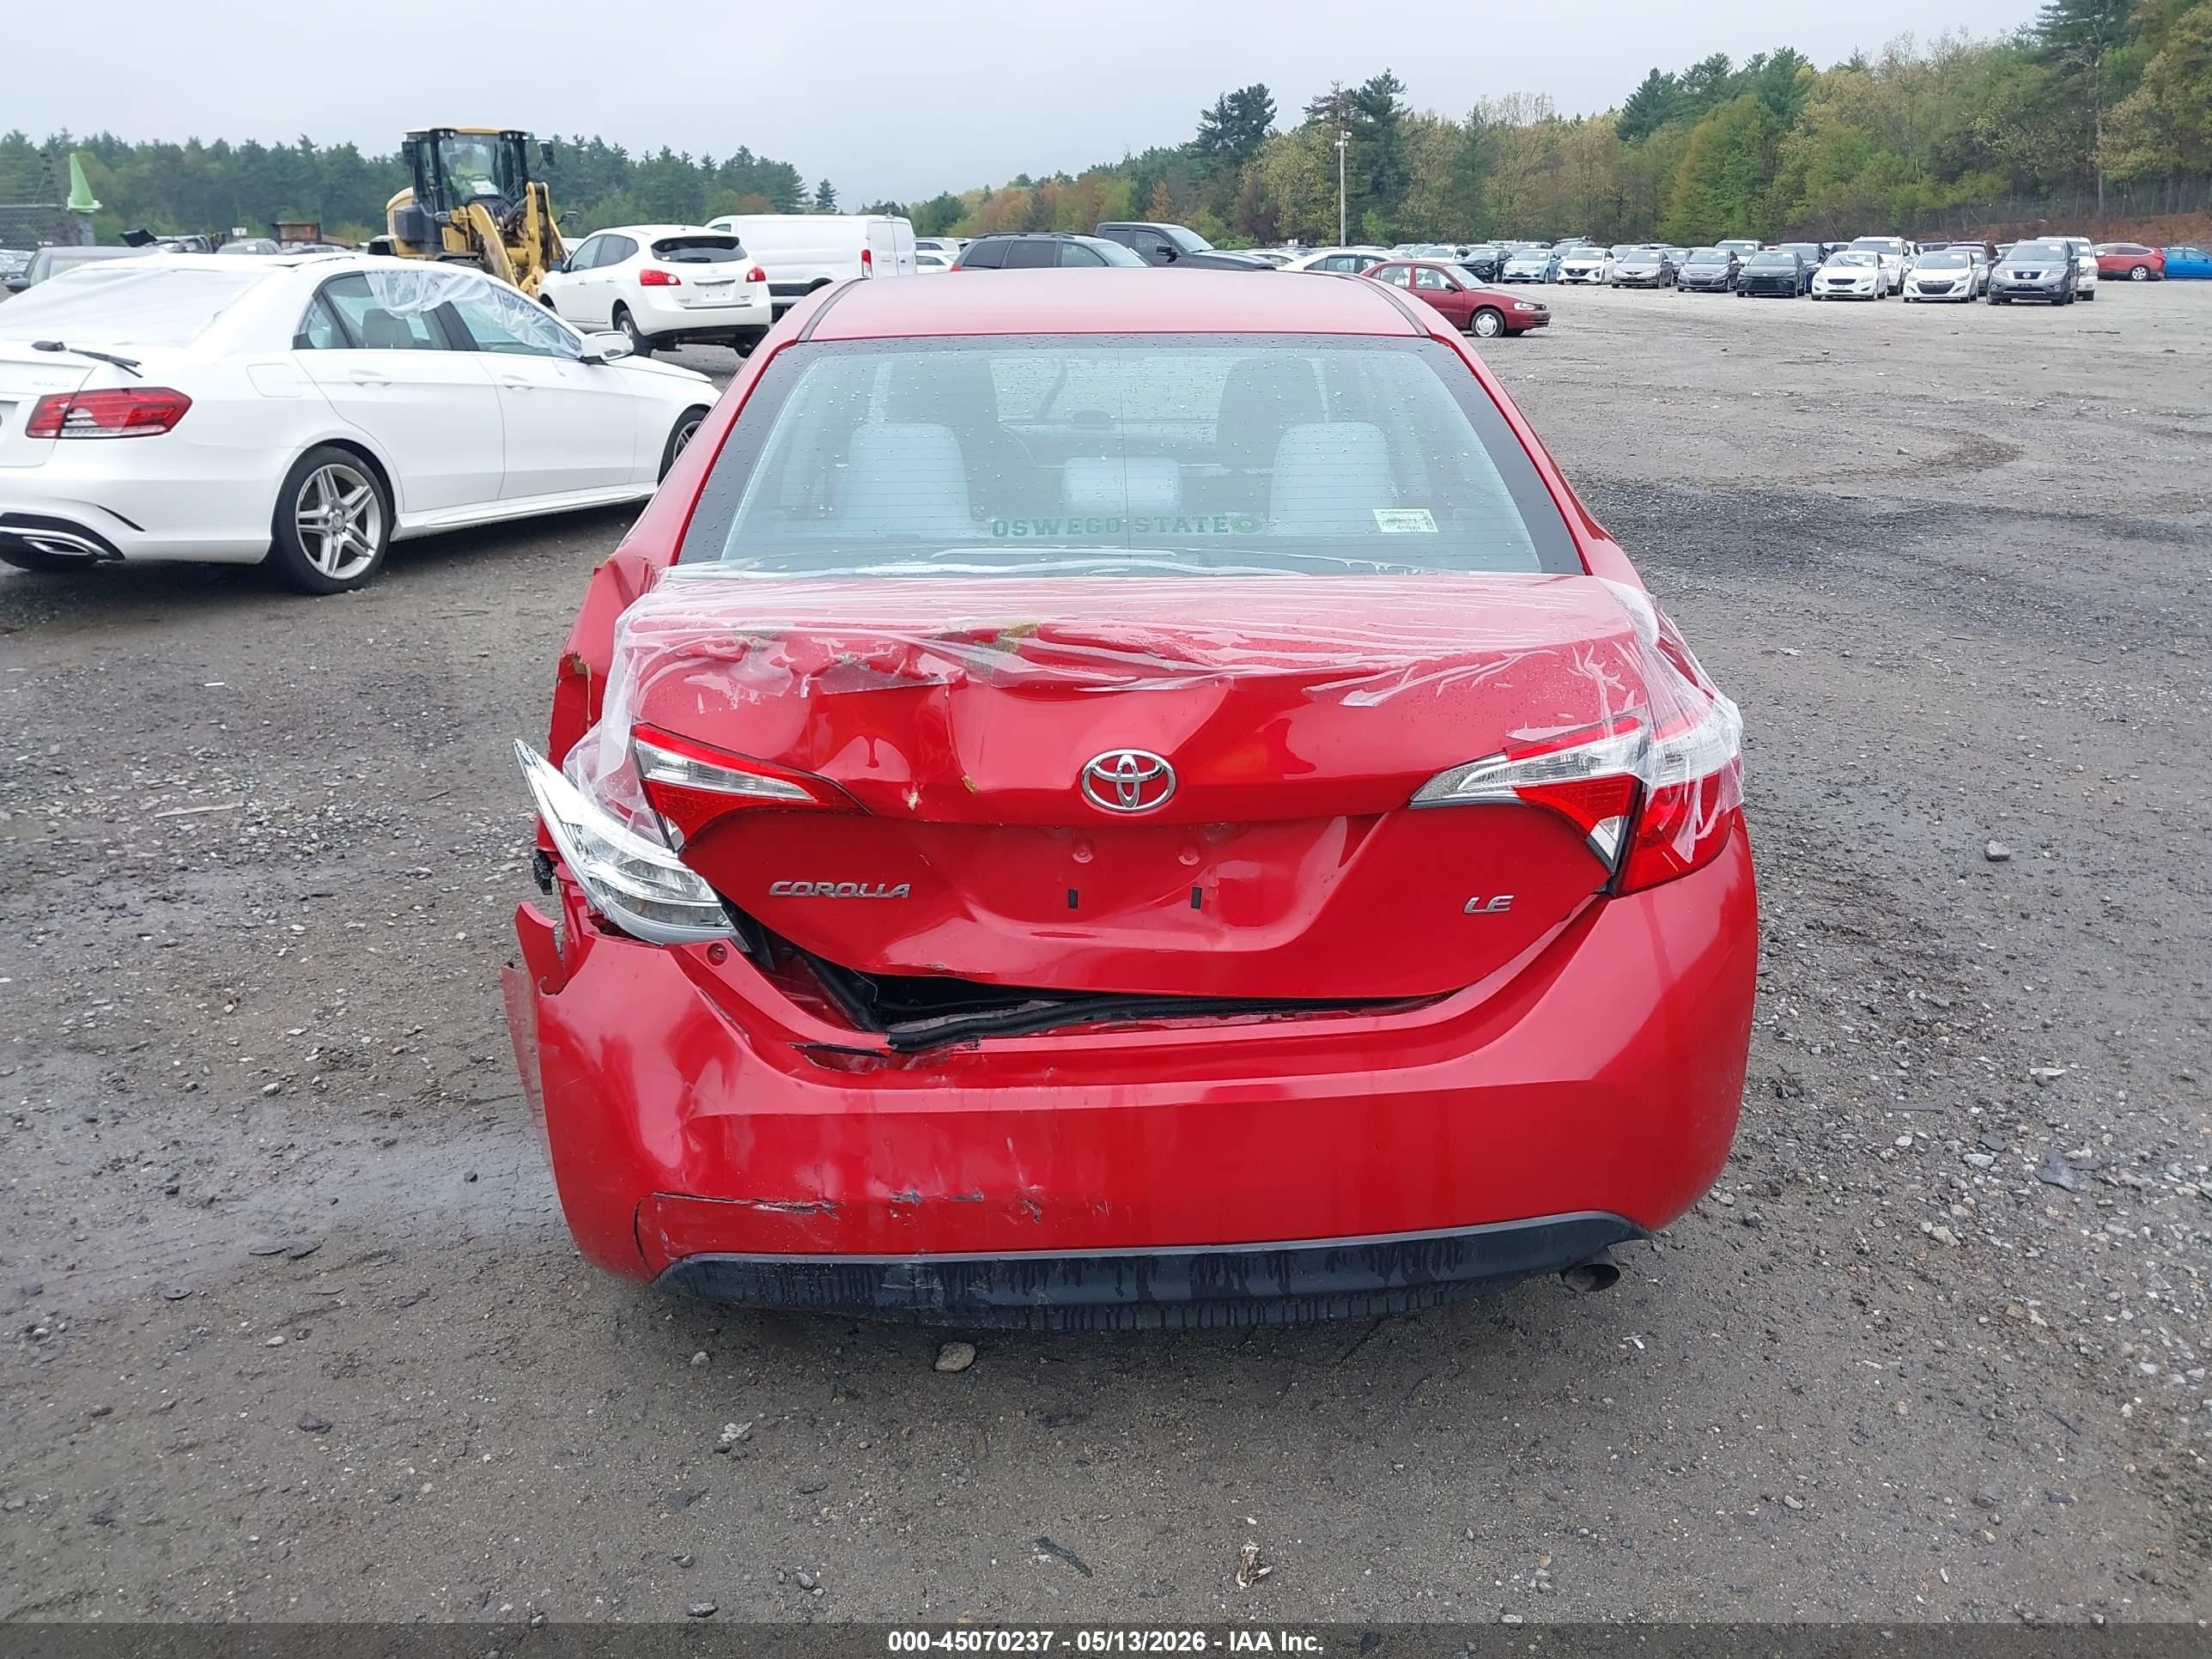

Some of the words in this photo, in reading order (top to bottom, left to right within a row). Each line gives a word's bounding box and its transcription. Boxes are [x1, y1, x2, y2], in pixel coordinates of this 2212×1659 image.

[992, 517, 1121, 537] OSWEGO
[1133, 516, 1229, 533] STATE
[769, 881, 910, 898] COROLLA
[1464, 895, 1515, 913] LE
